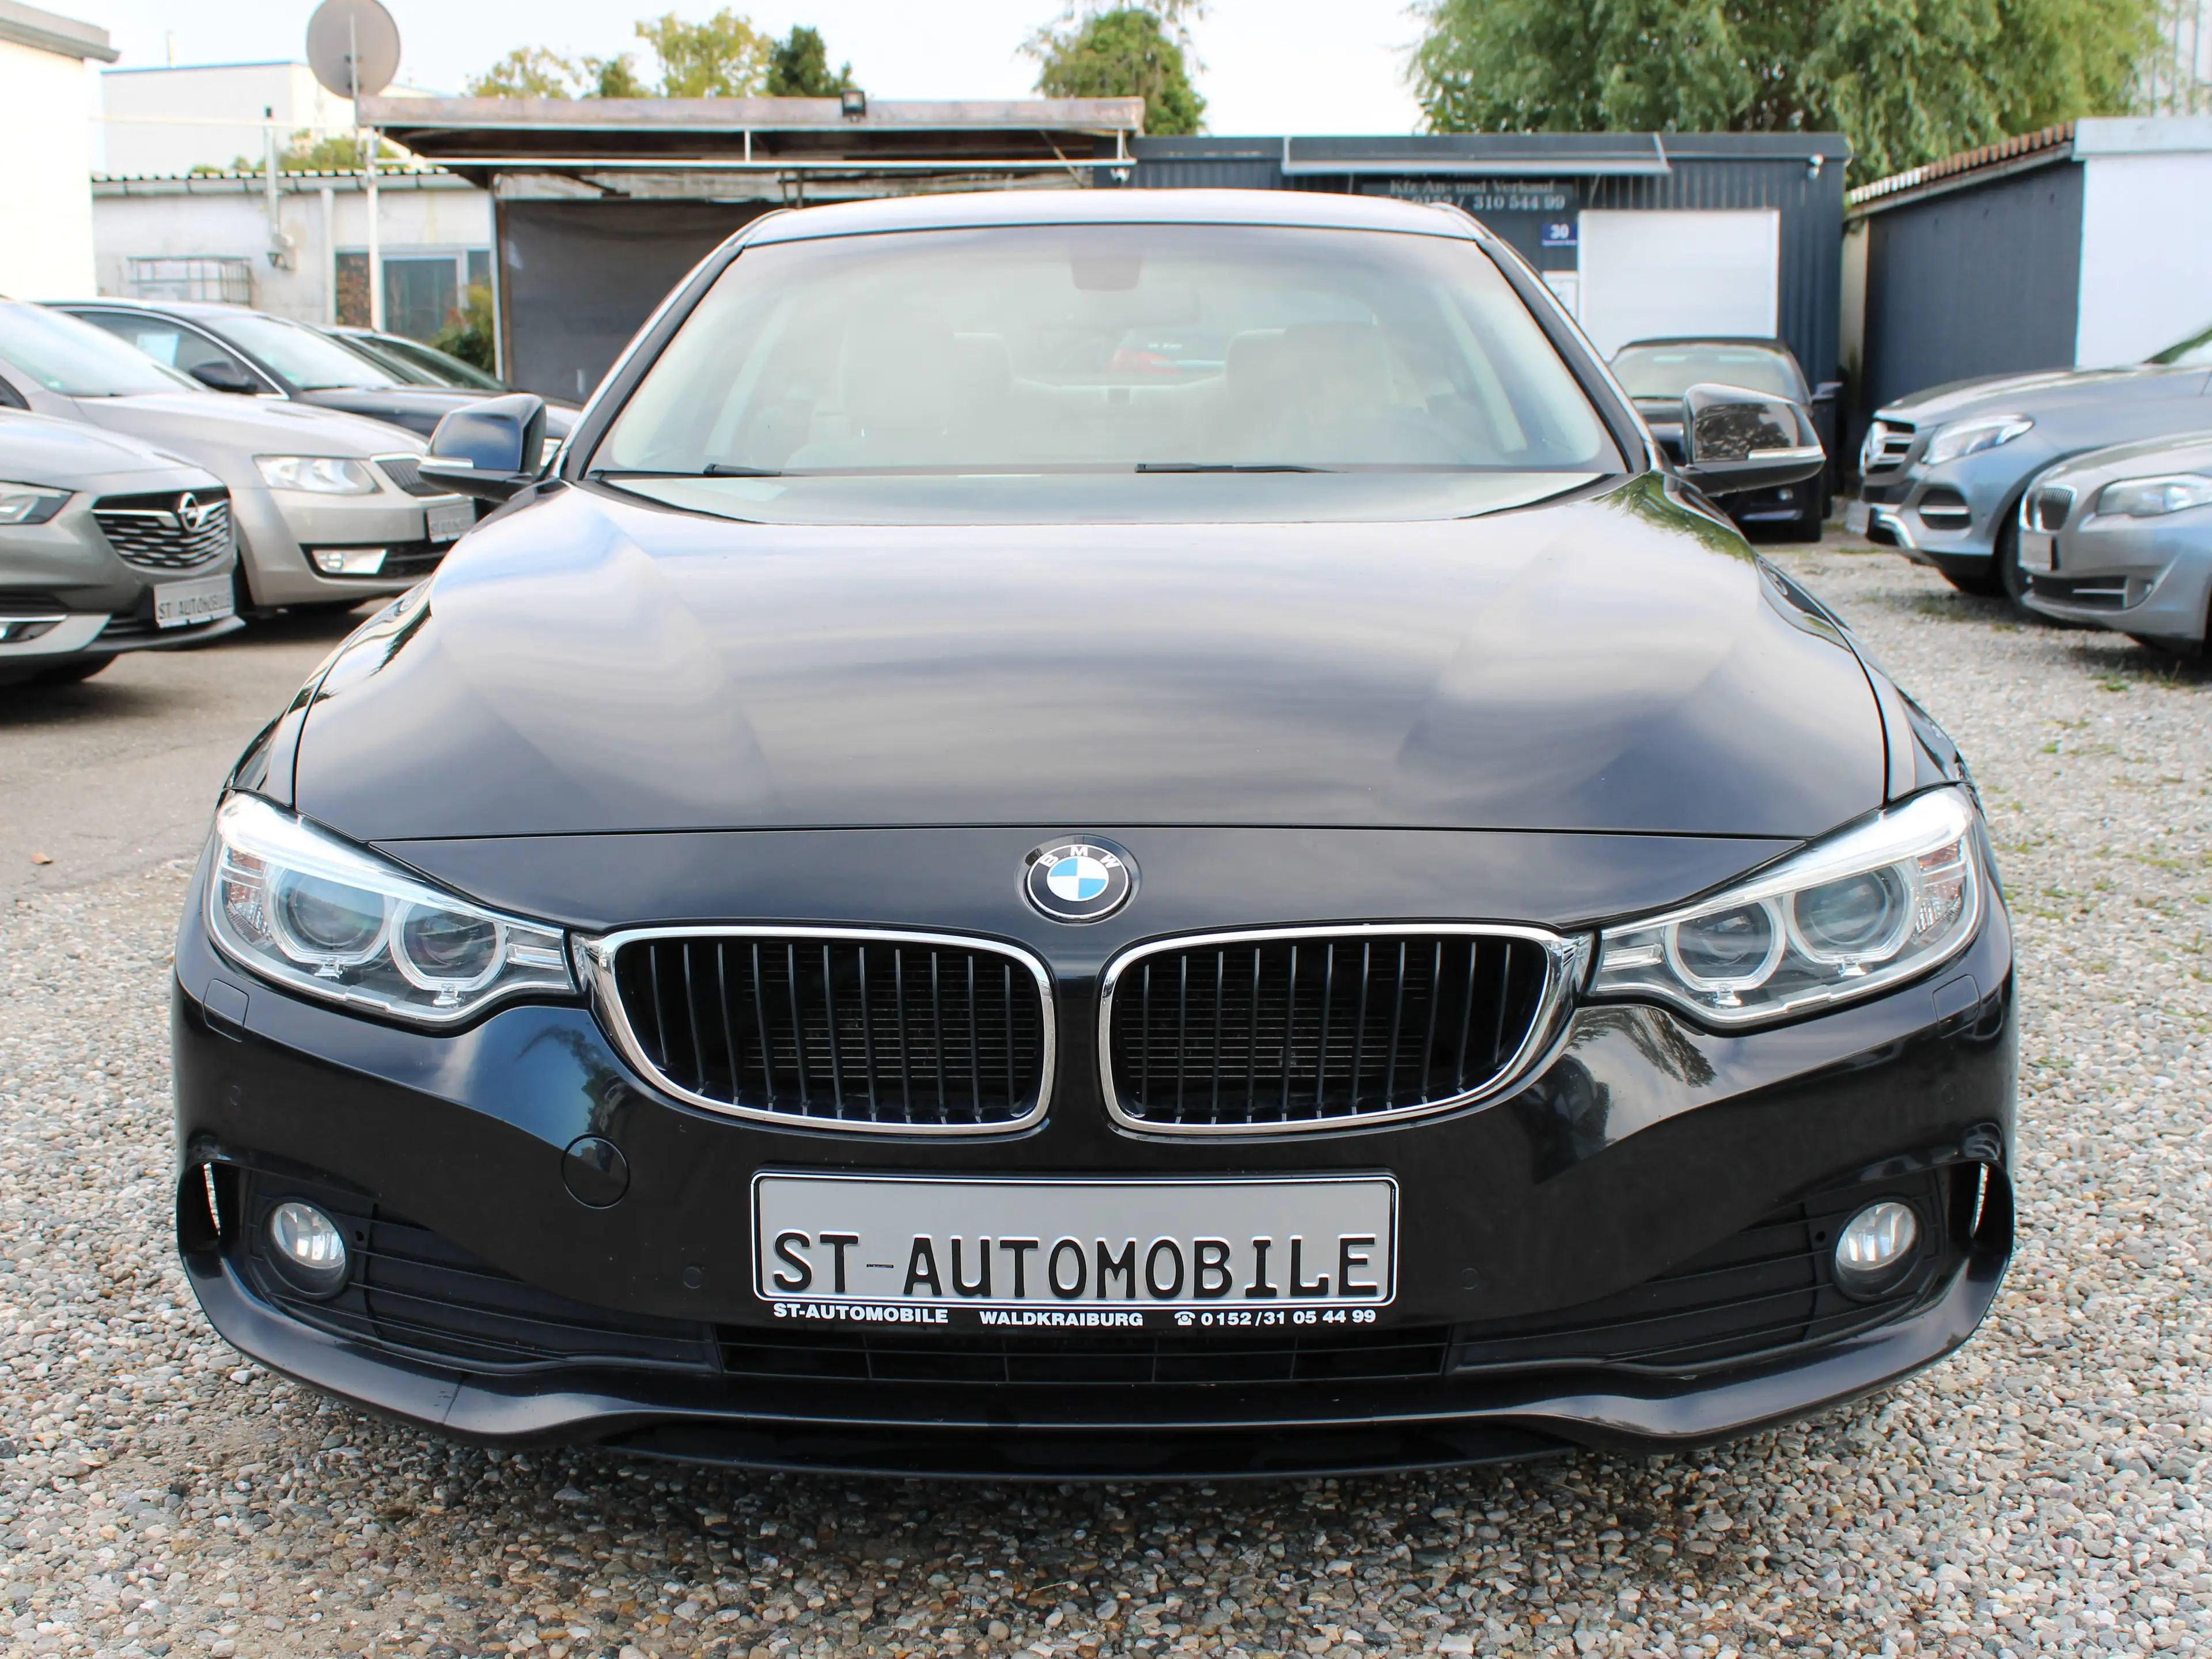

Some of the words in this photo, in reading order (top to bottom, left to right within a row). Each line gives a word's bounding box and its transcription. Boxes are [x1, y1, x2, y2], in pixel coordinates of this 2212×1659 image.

[1389, 180, 1418, 193] Kfz
[1422, 180, 1452, 193] An-
[1456, 180, 1486, 193] und
[1492, 179, 1554, 193] Verkauf
[1473, 195, 1505, 210] 310
[1509, 195, 1538, 210] 544
[1544, 195, 1566, 210] 99
[1550, 224, 1569, 239] 30
[1039, 846, 1120, 868] BMW
[773, 1302, 949, 1323] ST-AUTOMOBILE
[979, 1311, 1143, 1327] WALDKRAIBURG
[1293, 1310, 1317, 1324] 05
[1322, 1310, 1347, 1323] 44
[1352, 1309, 1376, 1323] 99
